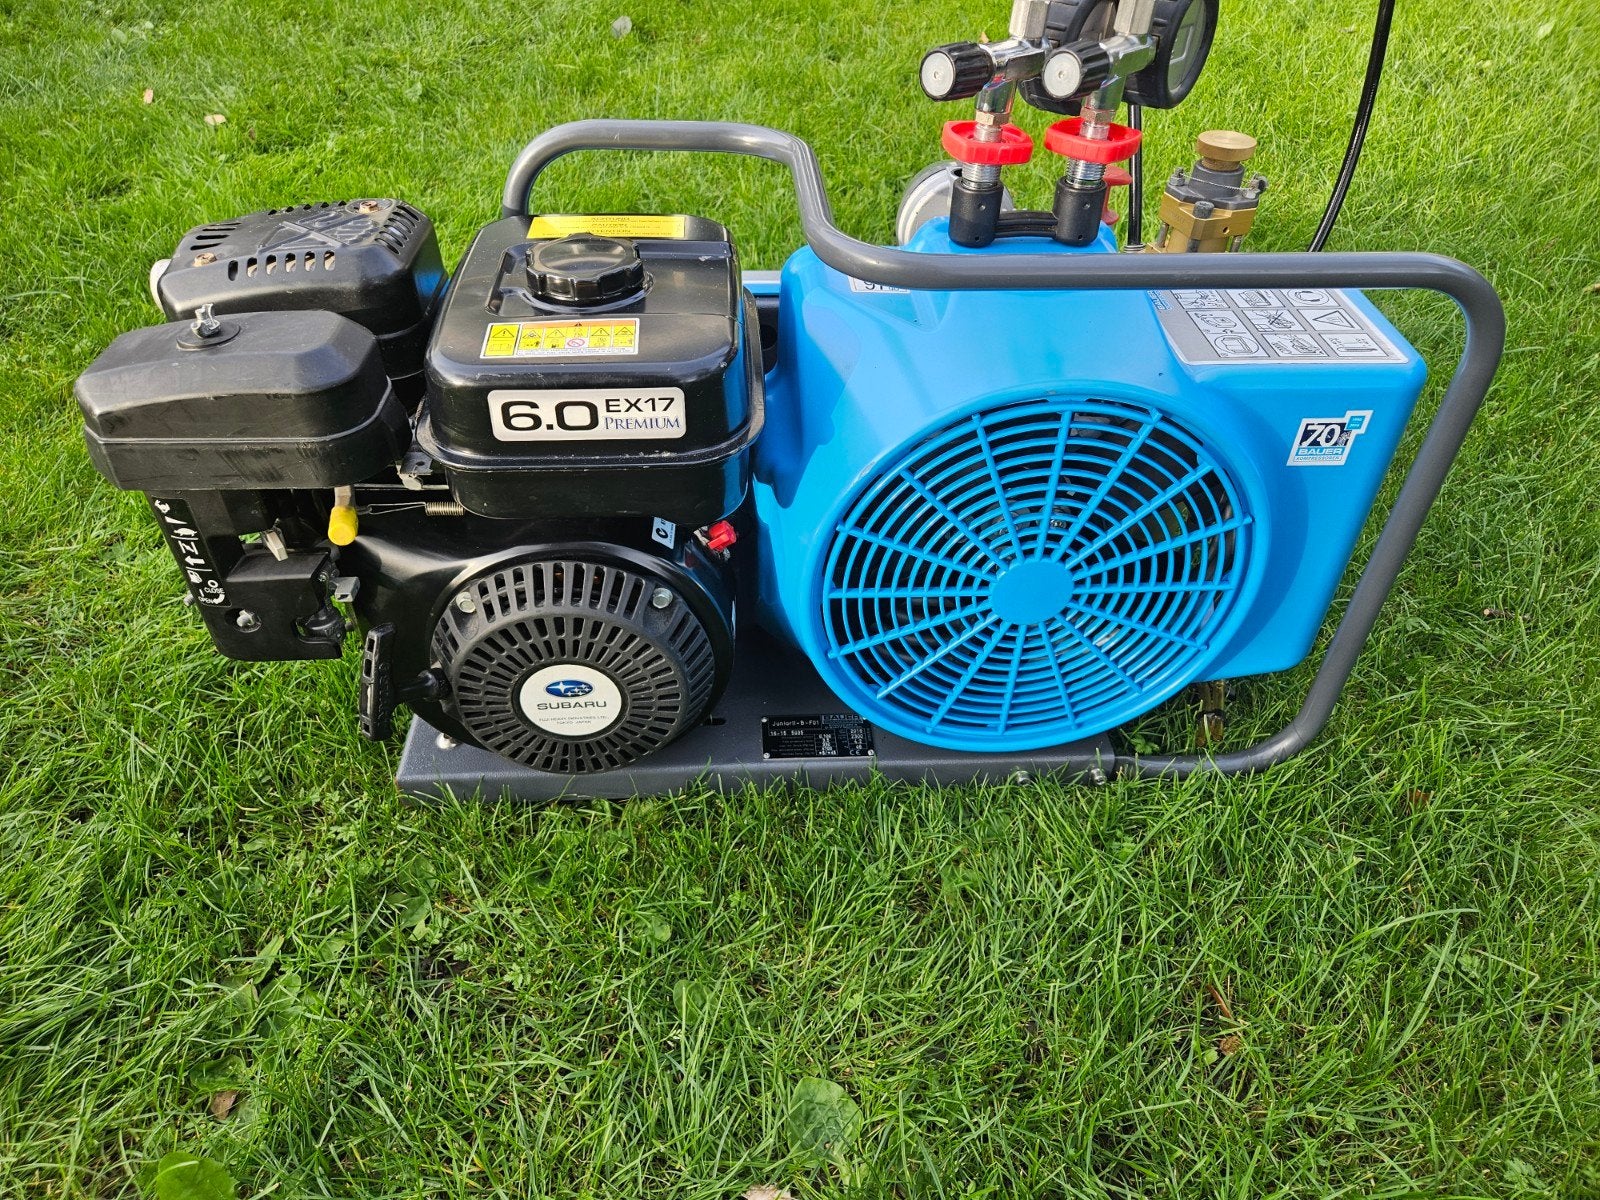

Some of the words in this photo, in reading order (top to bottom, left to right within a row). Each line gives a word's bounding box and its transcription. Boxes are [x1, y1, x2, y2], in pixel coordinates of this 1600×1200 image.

[605, 397, 675, 413] EX17
[500, 400, 599, 431] 6.0
[604, 415, 681, 430] PREMIUM
[1301, 424, 1341, 448] 70
[1298, 447, 1343, 455] BAUER
[537, 700, 607, 710] SUBARU
